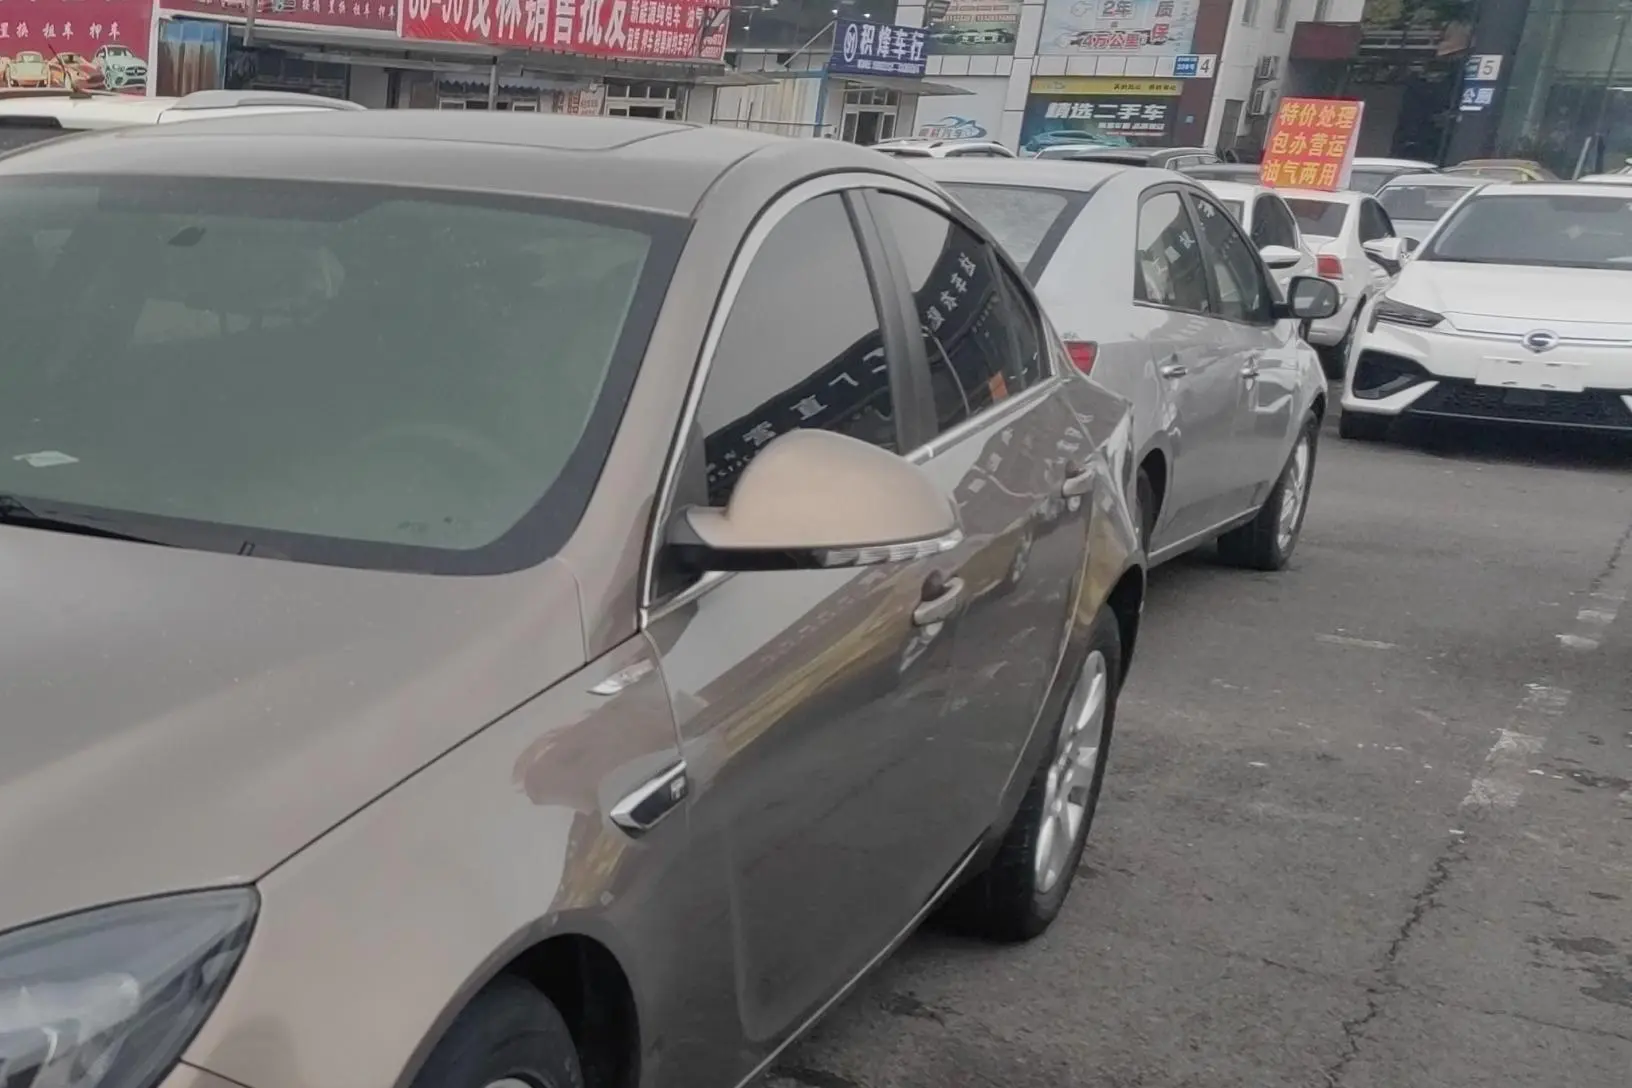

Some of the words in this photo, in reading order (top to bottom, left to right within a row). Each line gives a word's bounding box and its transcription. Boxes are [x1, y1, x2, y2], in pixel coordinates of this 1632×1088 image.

[1199, 59, 1210, 73] 4
[1482, 60, 1495, 75] 5
[1045, 102, 1166, 120] 精选二手车
[1280, 103, 1357, 128] 特价处理
[1272, 131, 1348, 158] 包办营运
[1264, 160, 1338, 186] 油气两用
